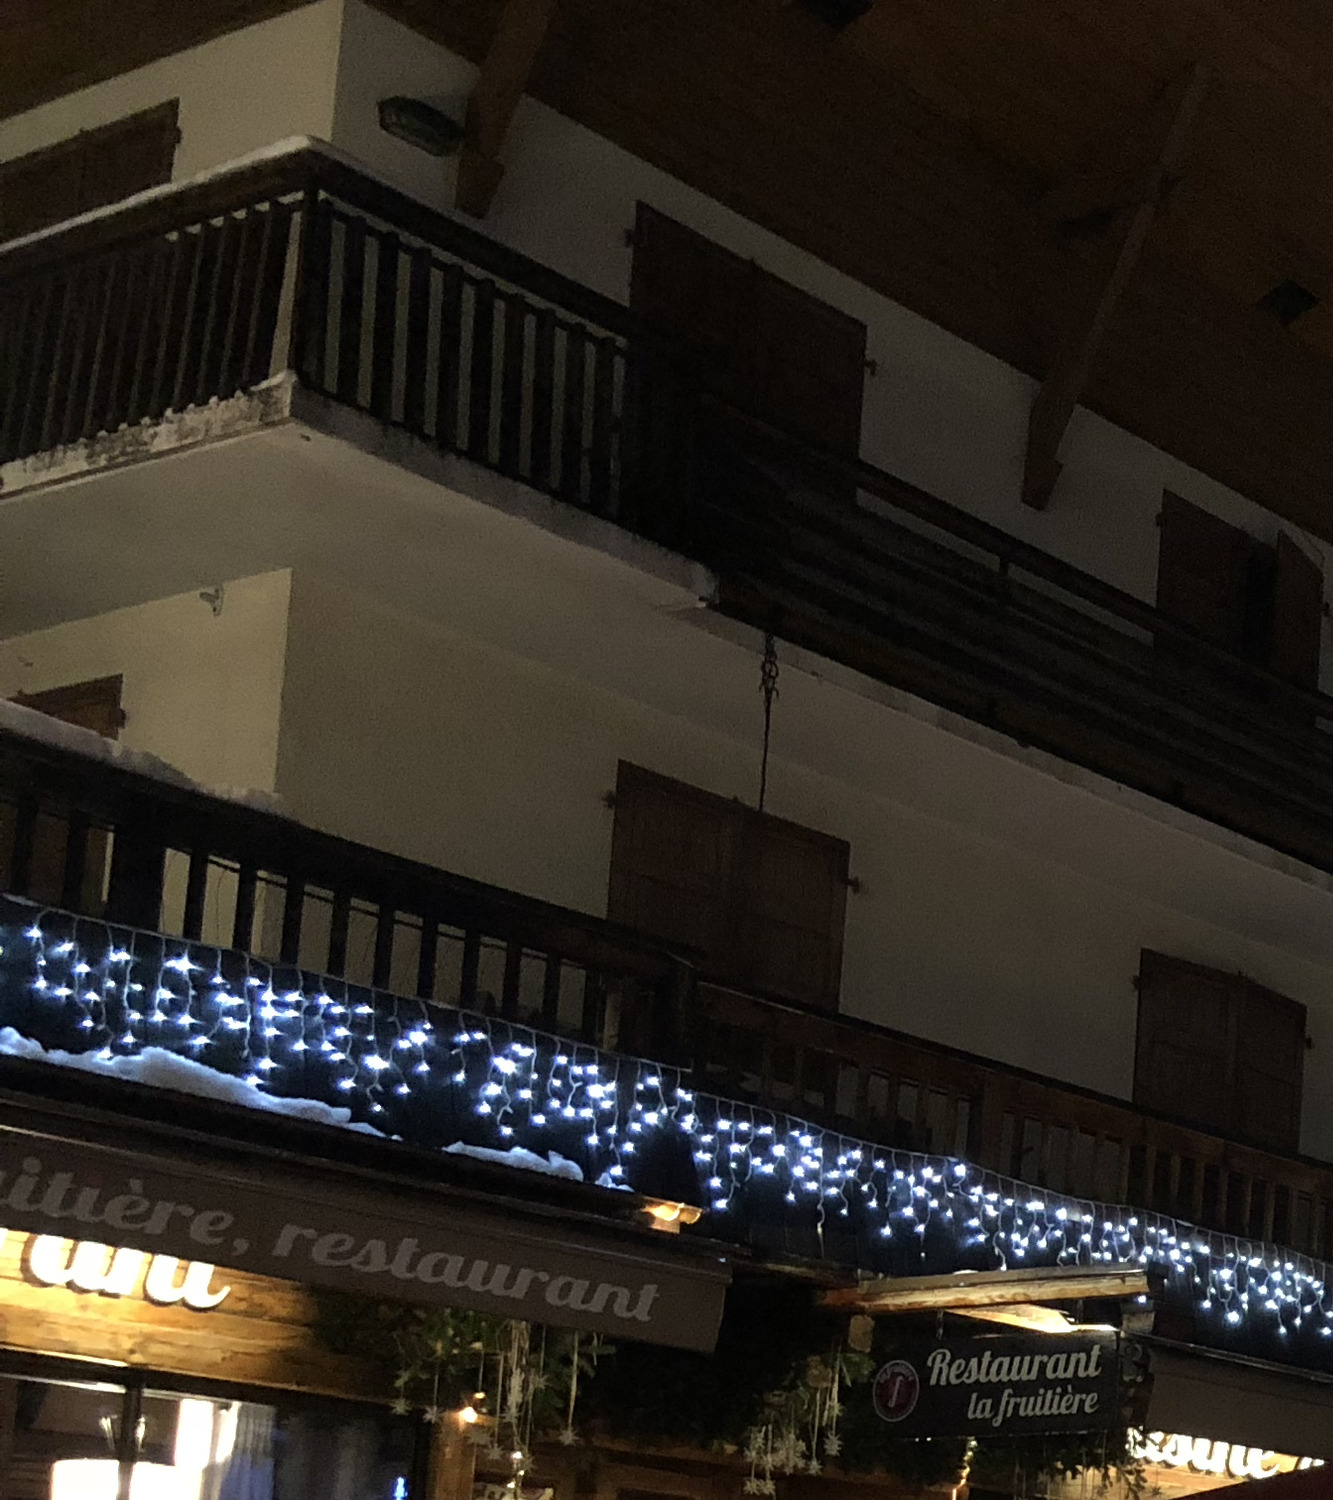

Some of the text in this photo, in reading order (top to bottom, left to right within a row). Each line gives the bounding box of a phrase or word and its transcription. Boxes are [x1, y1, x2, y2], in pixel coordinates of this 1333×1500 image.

[271, 1222, 661, 1324] restaurant
[926, 1344, 1102, 1386] Restaurant
[967, 1384, 1099, 1428] la fruitière
